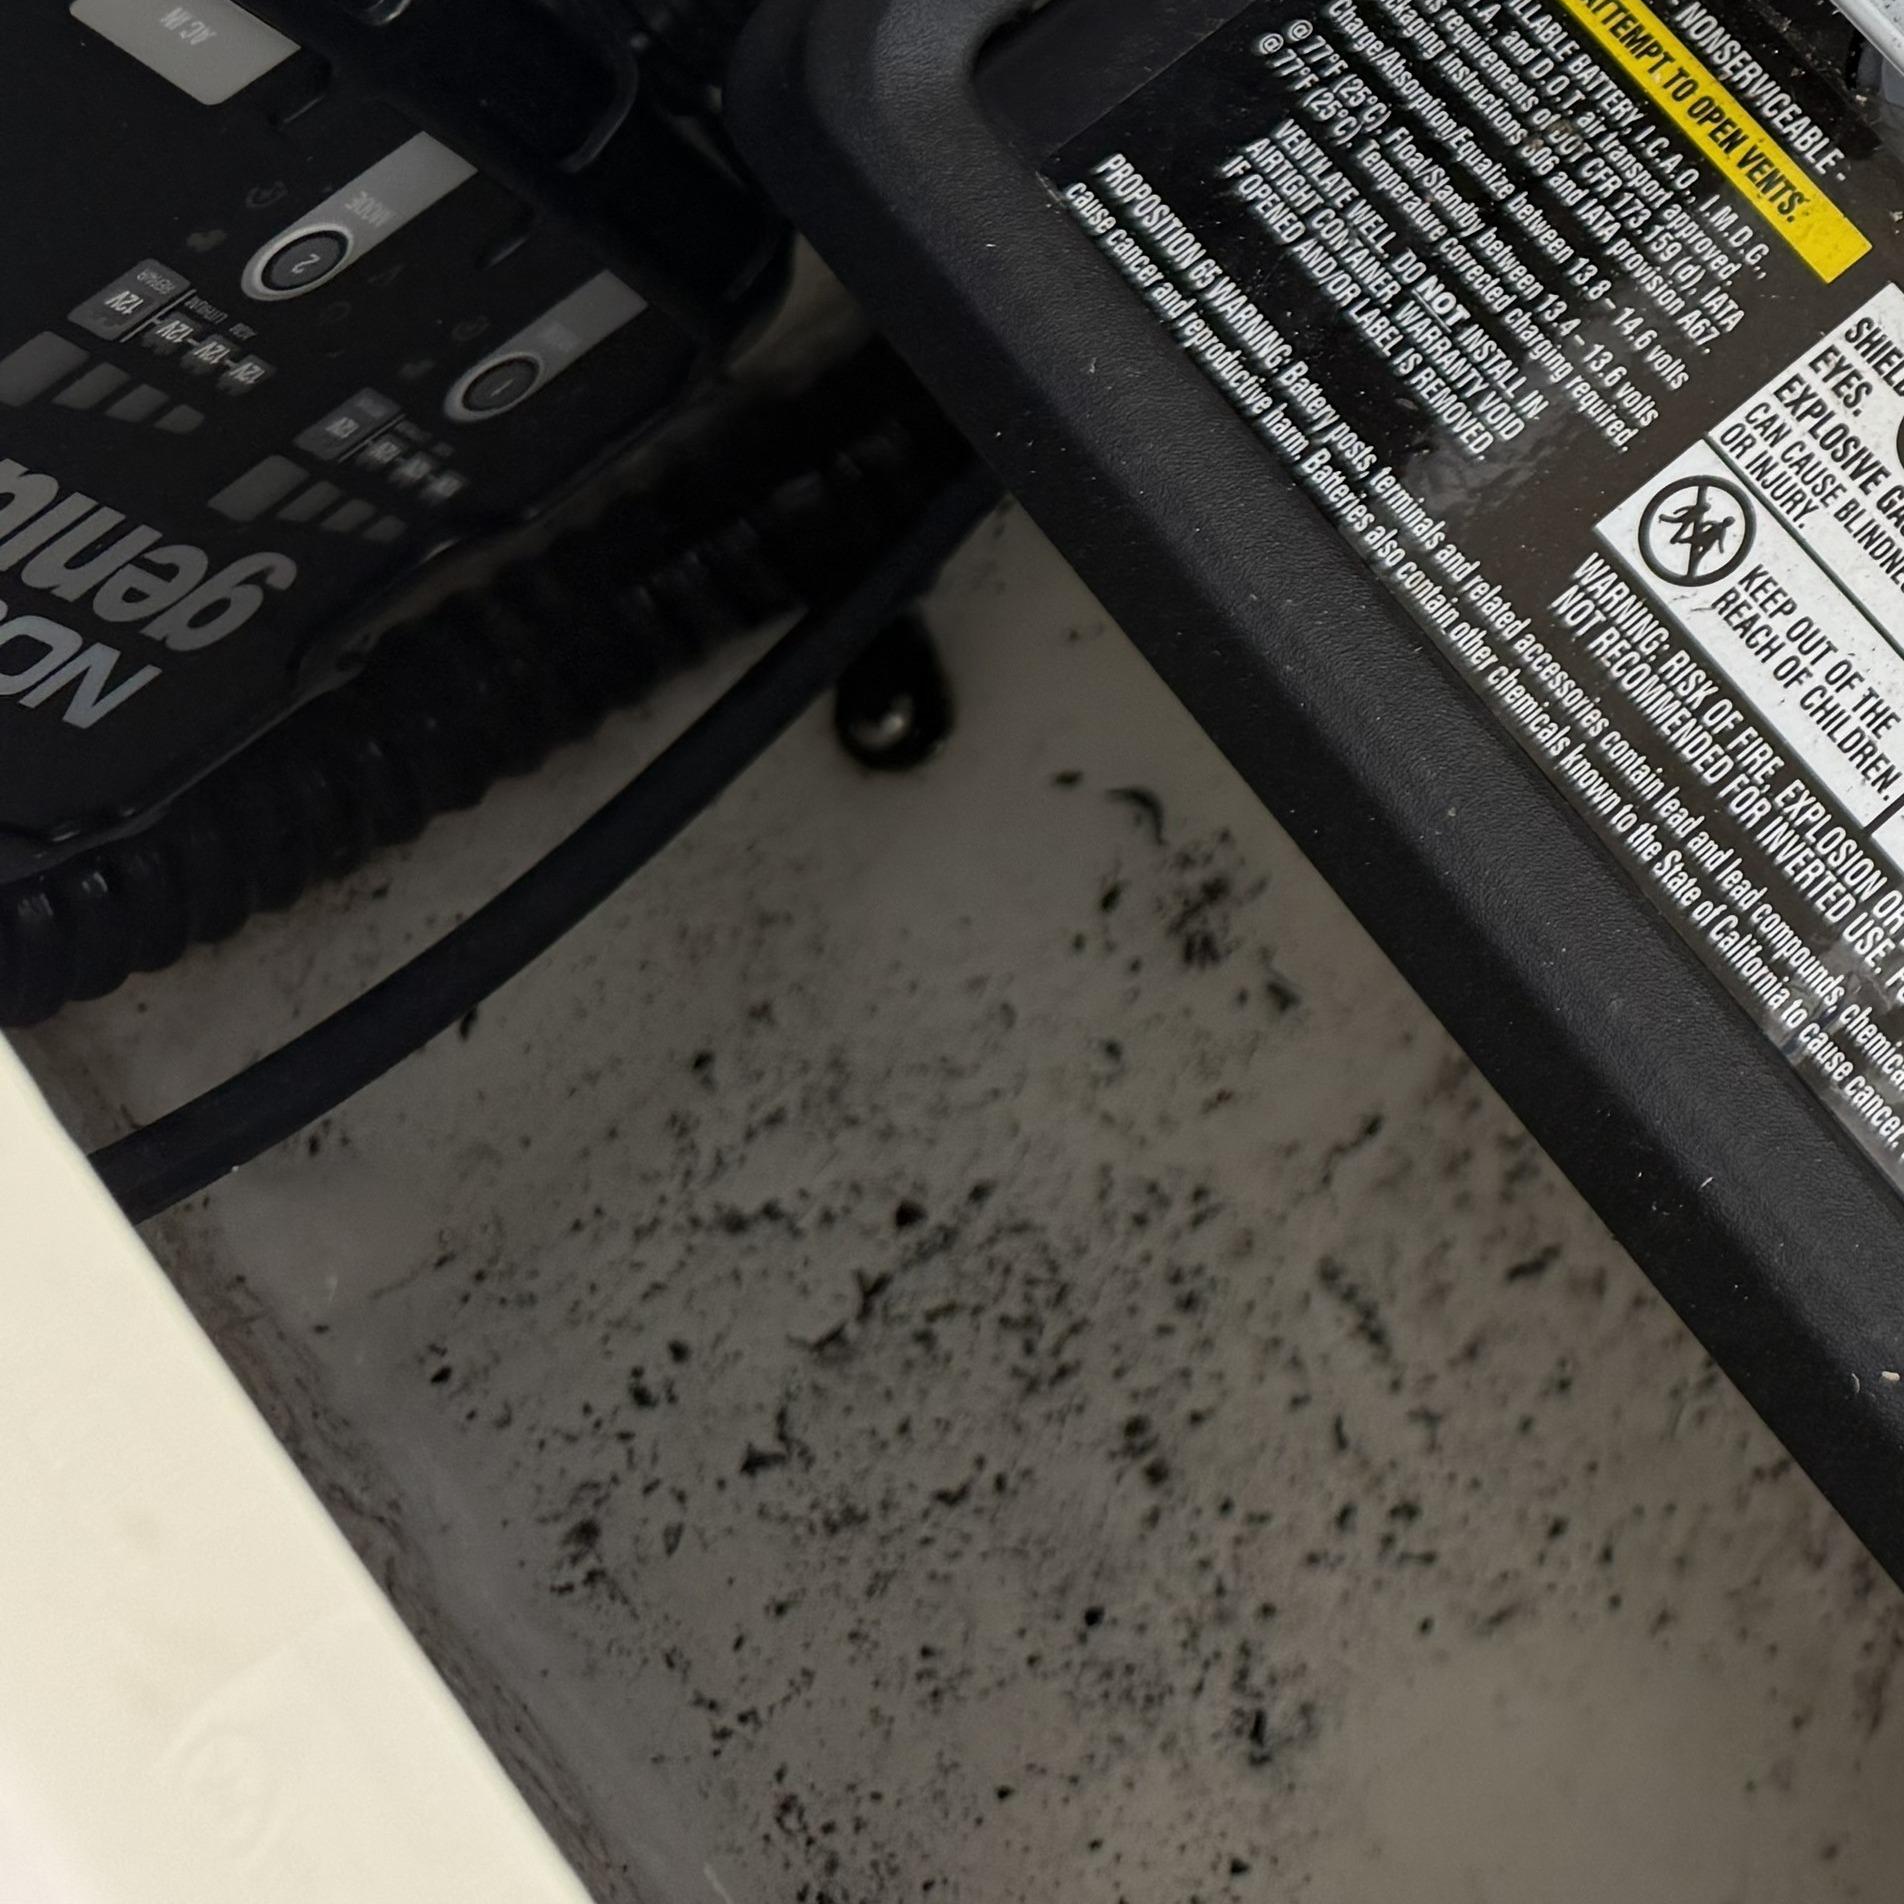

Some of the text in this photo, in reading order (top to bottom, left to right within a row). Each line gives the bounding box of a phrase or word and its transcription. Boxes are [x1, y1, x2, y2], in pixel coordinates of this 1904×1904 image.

[1495, 23, 1542, 67] and
[1526, 56, 1589, 117] D.O.T.
[1562, 52, 1647, 136] BATTERY,
[1672, 0, 1846, 176] NONSERVICEABLE
[1572, 105, 1613, 142] air
[1590, 129, 1675, 213] transport
[1658, 66, 1701, 104] TO
[1684, 93, 1749, 155] OPEN
[1731, 143, 1817, 227] VENTS.
[1242, 133, 1527, 443] AIRTIGHT CONTAINER. WARRANTY VOID
[1270, 118, 1551, 422] VENTILATE WELL. DO NOT INSTALL IN
[1654, 199, 1747, 291] approved.
[105, 289, 144, 317] 12V
[1092, 150, 1385, 482] PROPOSITION 65 WARNING: Battery posts,
[1217, 153, 1501, 462] IF OPENED AND/OR LABEL IS REMOVED.
[1770, 372, 1893, 496] EXPLOSIVE
[1805, 343, 1882, 418] EYES.
[1716, 420, 1824, 530] OR INJURY.
[1741, 400, 1794, 449] CAN
[1777, 438, 1849, 509] CAUSE
[1707, 586, 1787, 665] REACH
[1769, 653, 1814, 694] OF
[1735, 563, 1903, 740] KEEP OUT OF THE
